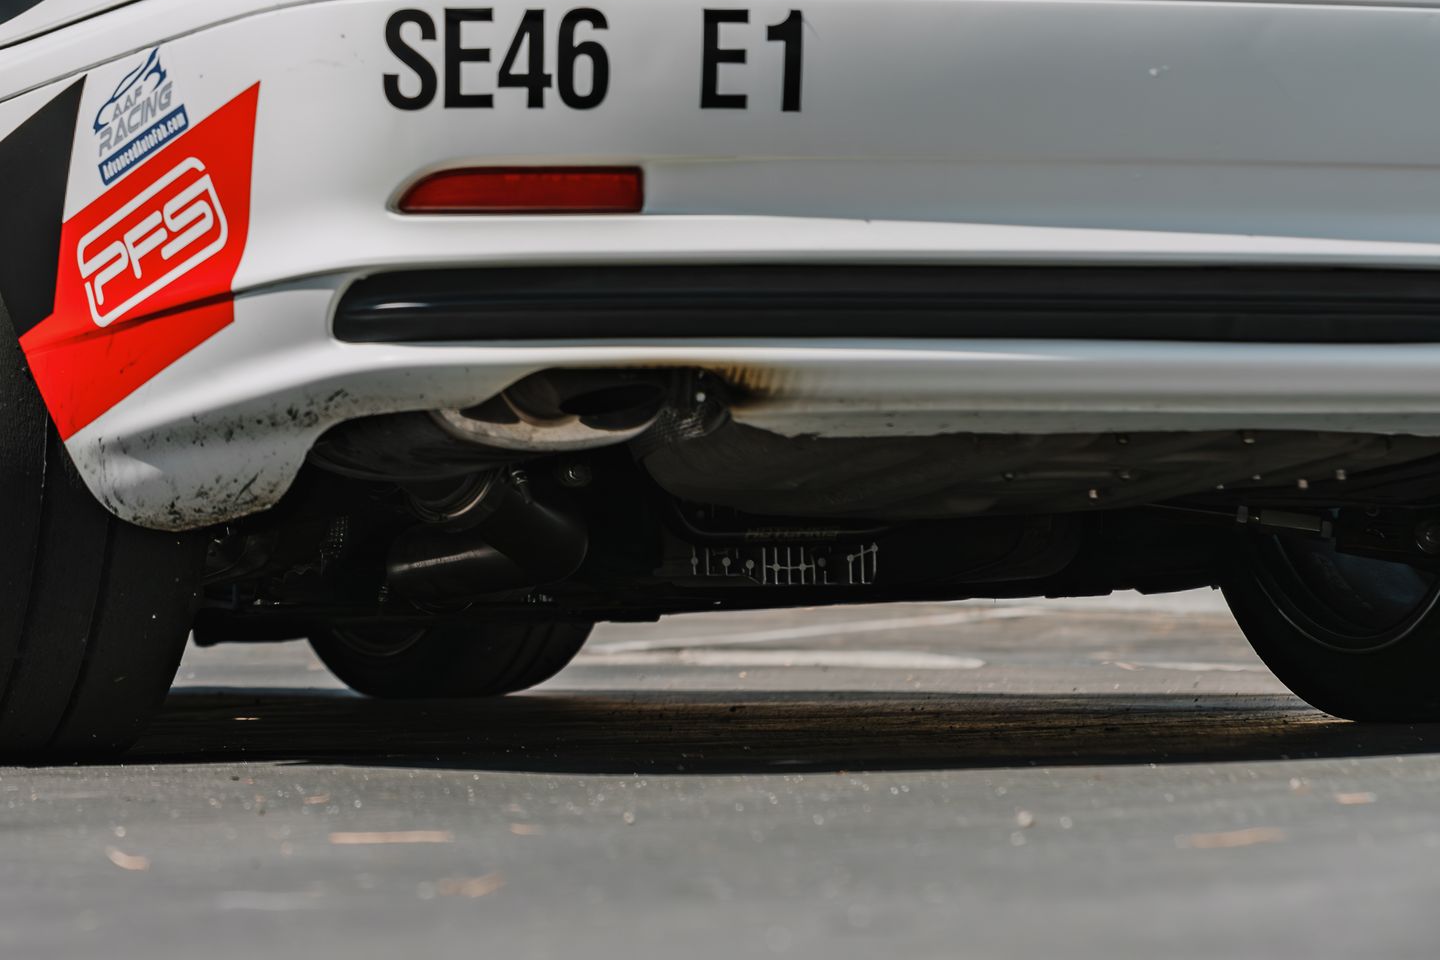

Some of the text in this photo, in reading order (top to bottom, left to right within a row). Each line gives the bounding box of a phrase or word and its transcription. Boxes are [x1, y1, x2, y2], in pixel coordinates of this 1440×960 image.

[383, 7, 803, 112] SE46 E1
[98, 80, 173, 158] RACING
[112, 84, 143, 122] AAF
[102, 112, 187, 181] AdvancedAutoFab.com
[81, 178, 216, 307] PFS
